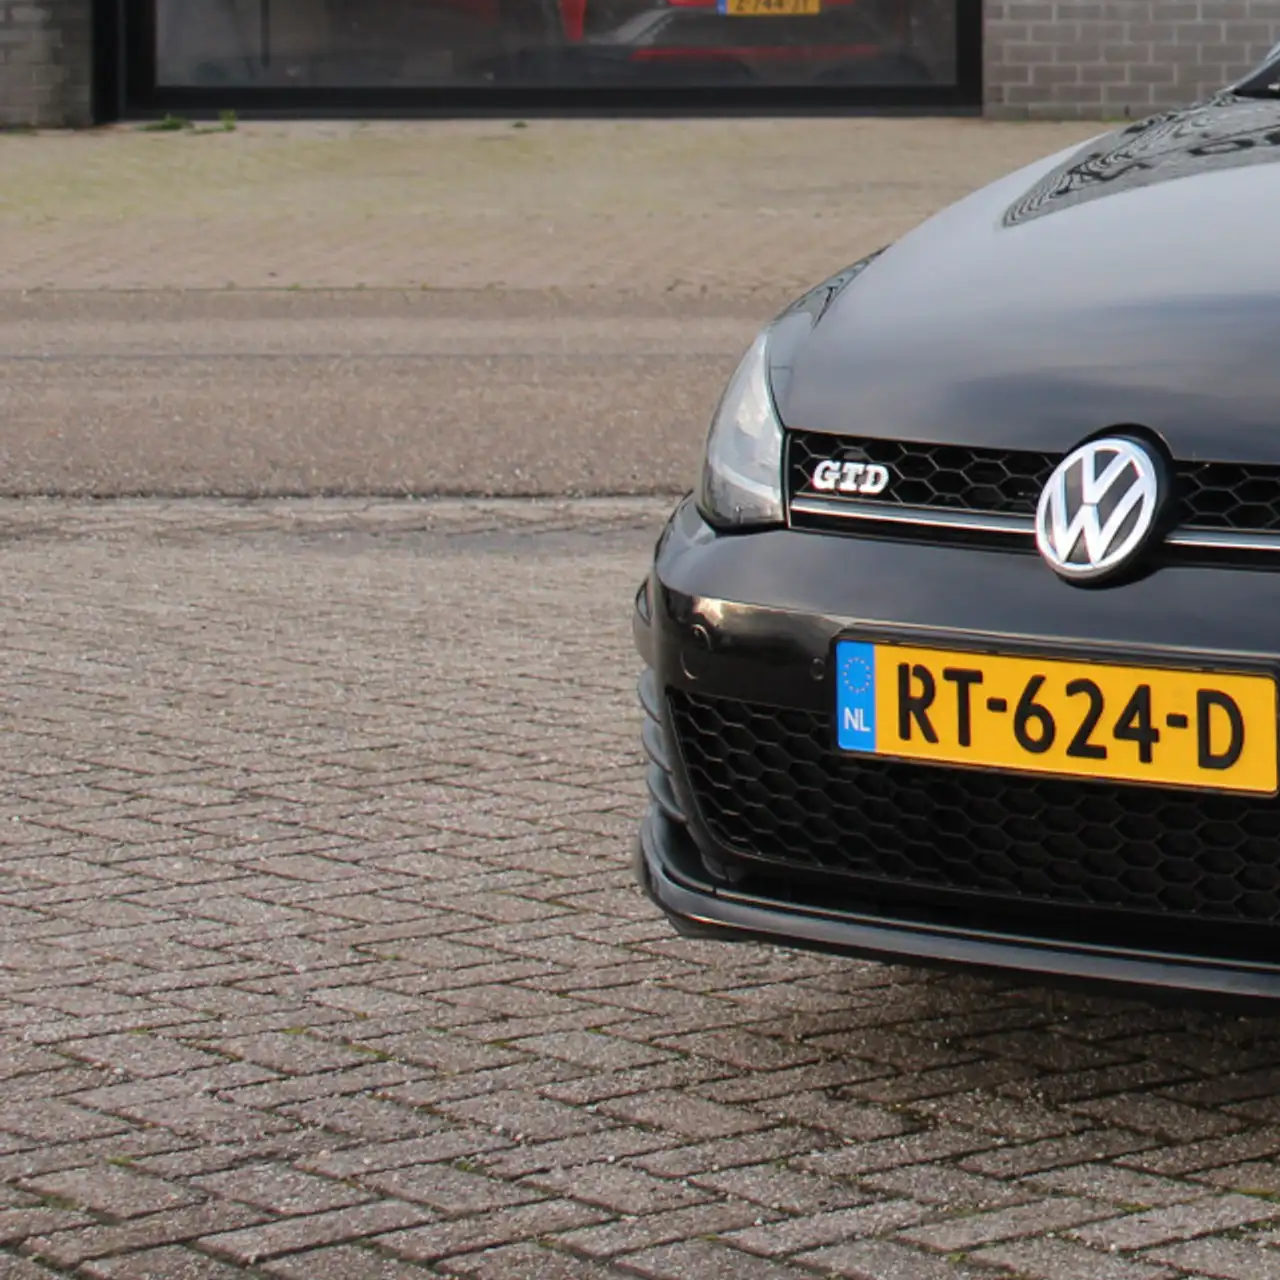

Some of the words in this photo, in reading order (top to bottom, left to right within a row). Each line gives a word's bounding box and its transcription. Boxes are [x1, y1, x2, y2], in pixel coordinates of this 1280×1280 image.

[813, 460, 890, 494] GTD
[843, 706, 870, 732] NL
[897, 663, 1245, 770] RT-624-D
